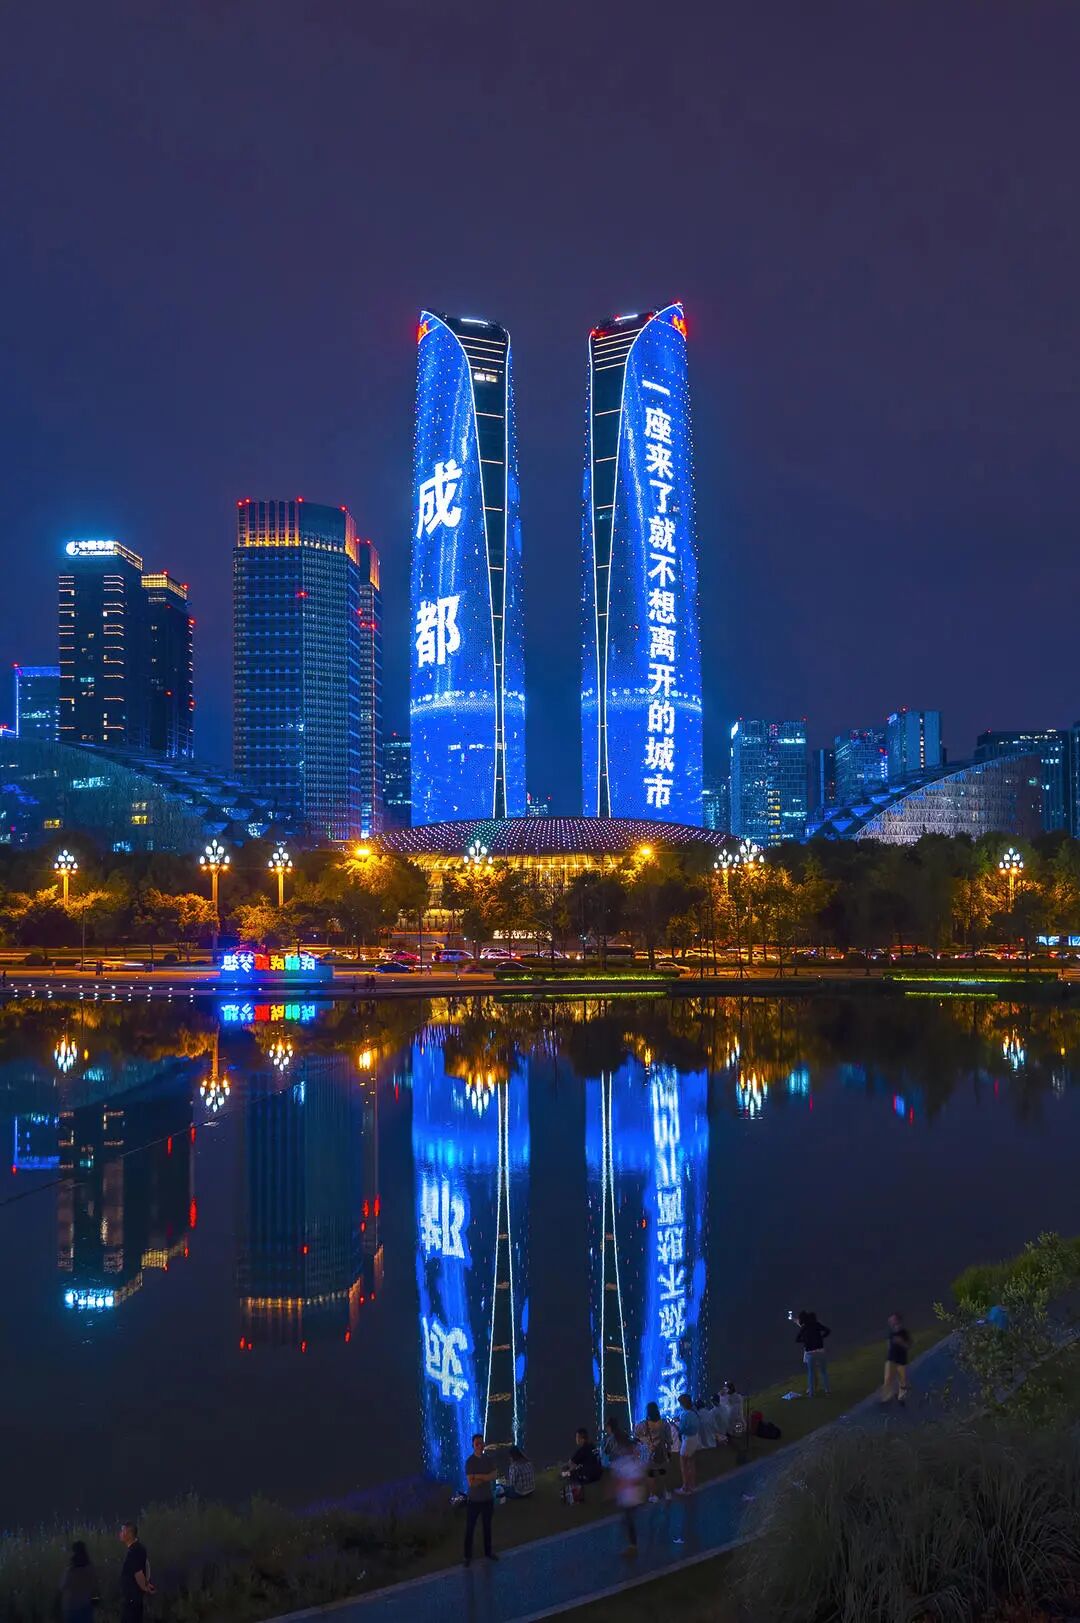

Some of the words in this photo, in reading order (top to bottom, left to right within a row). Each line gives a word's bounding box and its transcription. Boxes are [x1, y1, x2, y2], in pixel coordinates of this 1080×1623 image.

[415, 458, 463, 668] 成都
[638, 379, 678, 809] 一座来了就不想离开的城市
